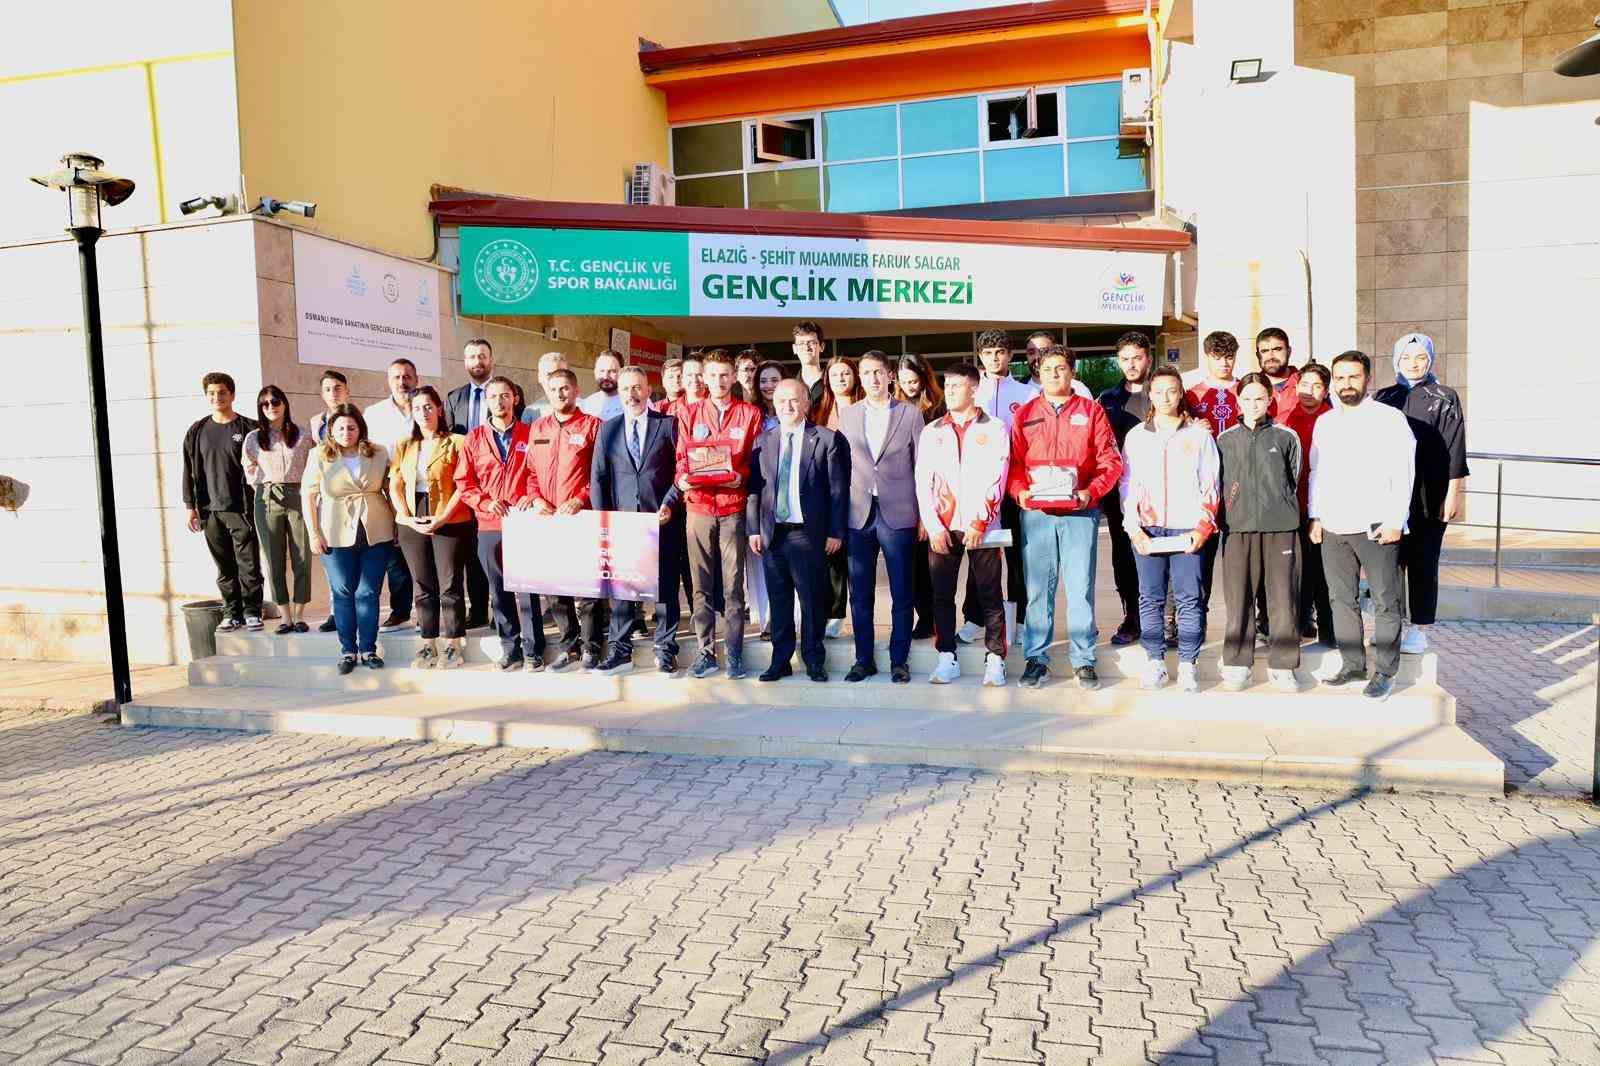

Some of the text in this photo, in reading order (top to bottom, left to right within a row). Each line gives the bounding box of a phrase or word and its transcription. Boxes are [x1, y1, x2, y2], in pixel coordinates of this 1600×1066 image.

[548, 258, 672, 276] T.C. GENÇLİK VE
[701, 245, 747, 264] ELAZIĞ
[760, 246, 796, 269] ŞEHİT
[799, 250, 869, 267] MUAMMER
[872, 253, 911, 269] FARUK
[914, 255, 961, 271] SALGAR
[547, 275, 678, 291] SPOR BAKANLIĞI
[702, 269, 974, 308] GENÇLİK MERKEZİ
